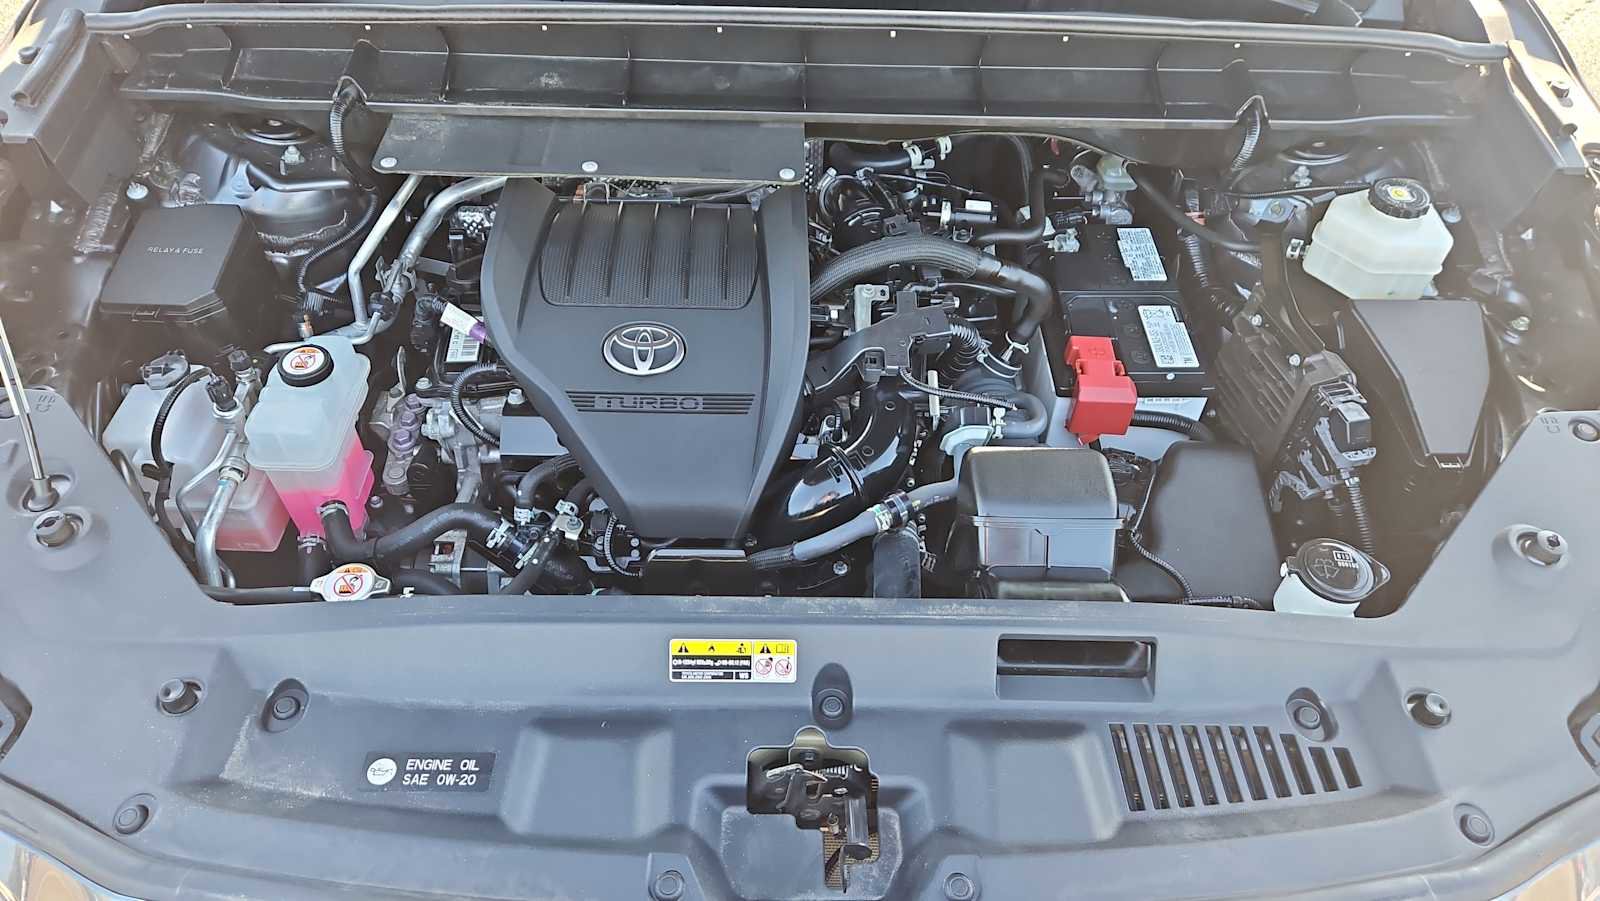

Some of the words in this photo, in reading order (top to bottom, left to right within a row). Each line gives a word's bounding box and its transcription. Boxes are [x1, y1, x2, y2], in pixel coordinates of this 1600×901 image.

[147, 246, 174, 254] RELAY
[183, 247, 204, 255] FUSE
[598, 395, 700, 411] TURBO
[405, 758, 454, 771] ENGINE
[460, 759, 480, 771] OIL
[402, 773, 430, 786] SAE
[436, 774, 477, 786] 0W-20
